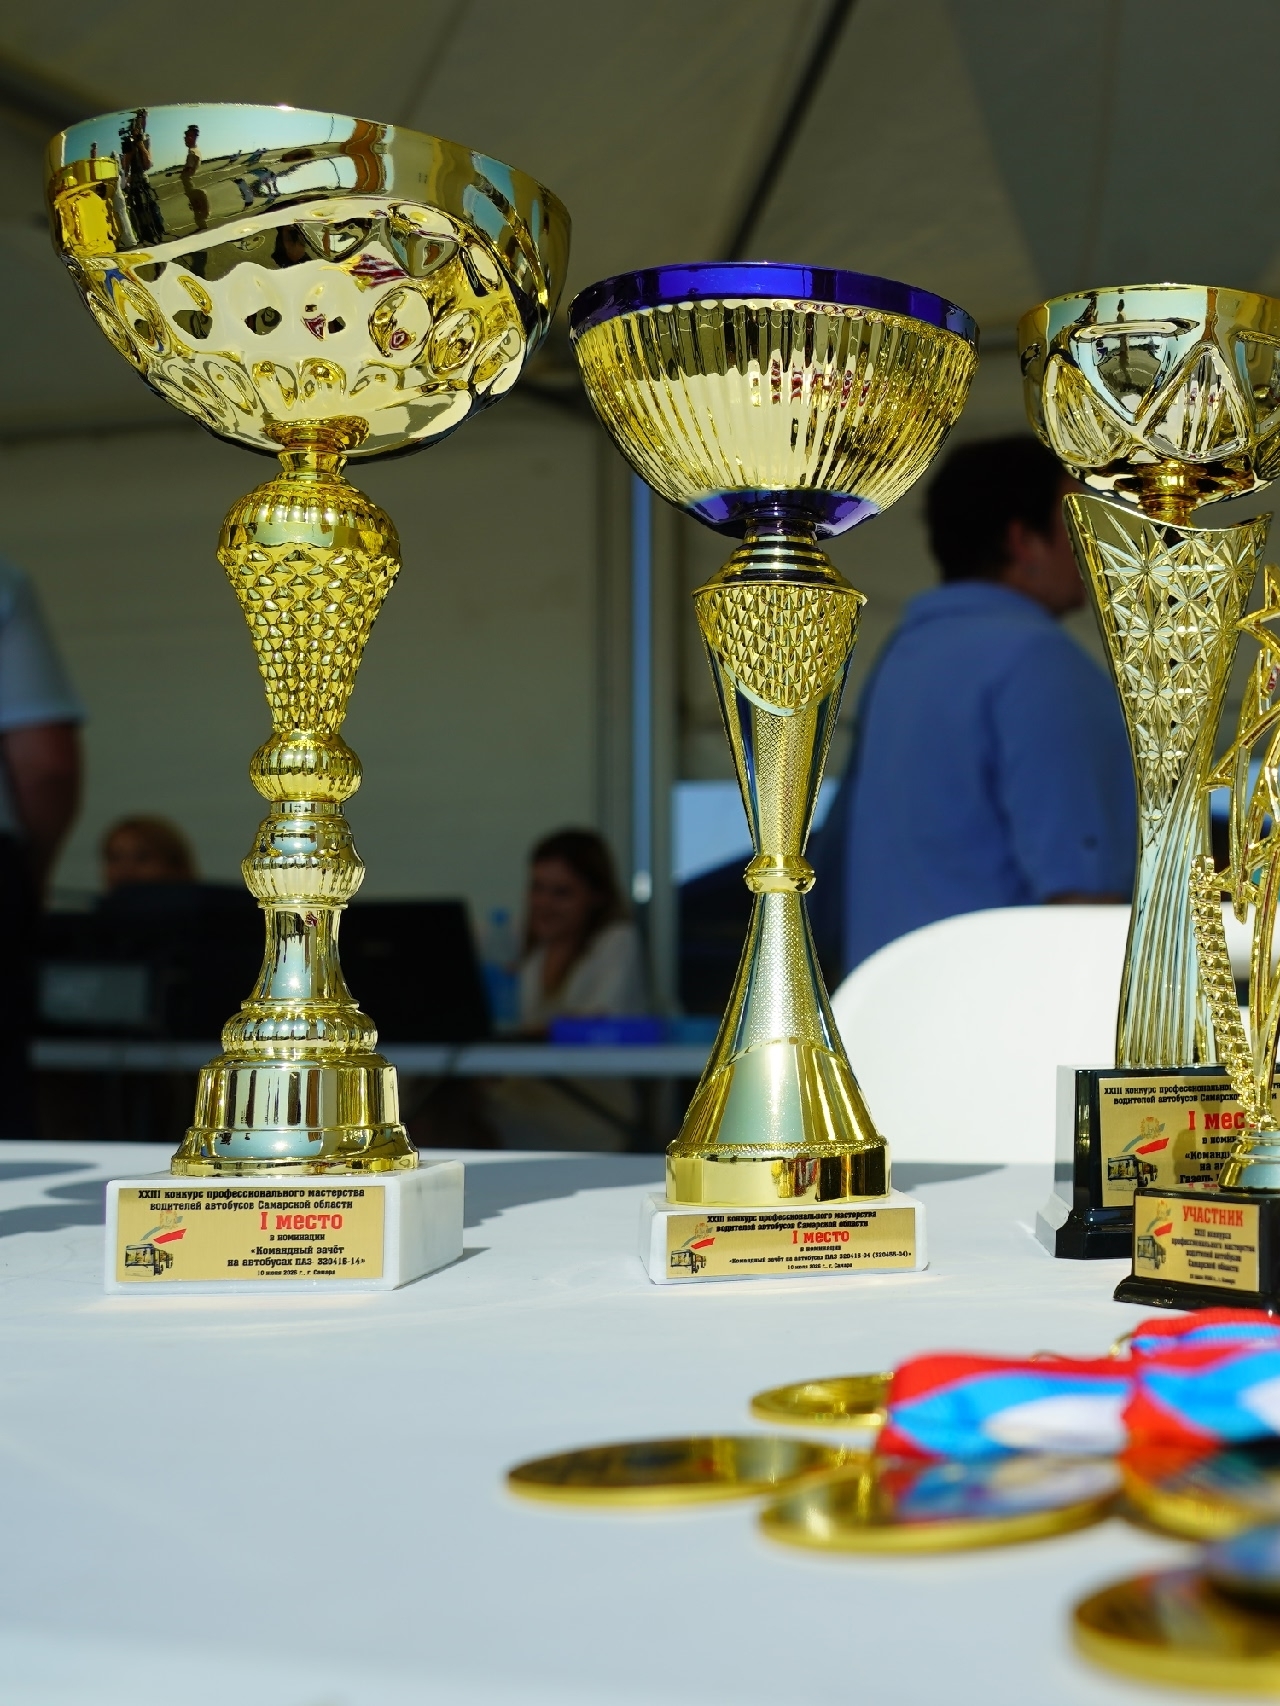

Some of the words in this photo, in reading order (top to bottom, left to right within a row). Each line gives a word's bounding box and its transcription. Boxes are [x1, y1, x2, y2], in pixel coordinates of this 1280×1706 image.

[1104, 1087, 1122, 1095] XXIII
[1125, 1086, 1156, 1096] конкурс
[1159, 1084, 1232, 1094] профессионально
[1201, 1092, 1240, 1103] Самарско
[1204, 1111, 1255, 1130] мес
[138, 1189, 161, 1199] XXIII
[164, 1190, 204, 1200] конкурс
[206, 1188, 305, 1200] профессионального
[308, 1188, 365, 1199] мастерства
[150, 1201, 202, 1211] водителей
[205, 1200, 254, 1211] автобусов
[258, 1199, 311, 1210] Самарской
[314, 1199, 353, 1210] области
[275, 1213, 343, 1230] место
[1182, 1205, 1244, 1227] УЧАСТНИК
[277, 1233, 325, 1242] номинации
[803, 1230, 850, 1243] место
[250, 1245, 313, 1256] «Командный
[316, 1244, 345, 1255] зачёт
[227, 1258, 239, 1267] на
[242, 1257, 293, 1268] автобусах
